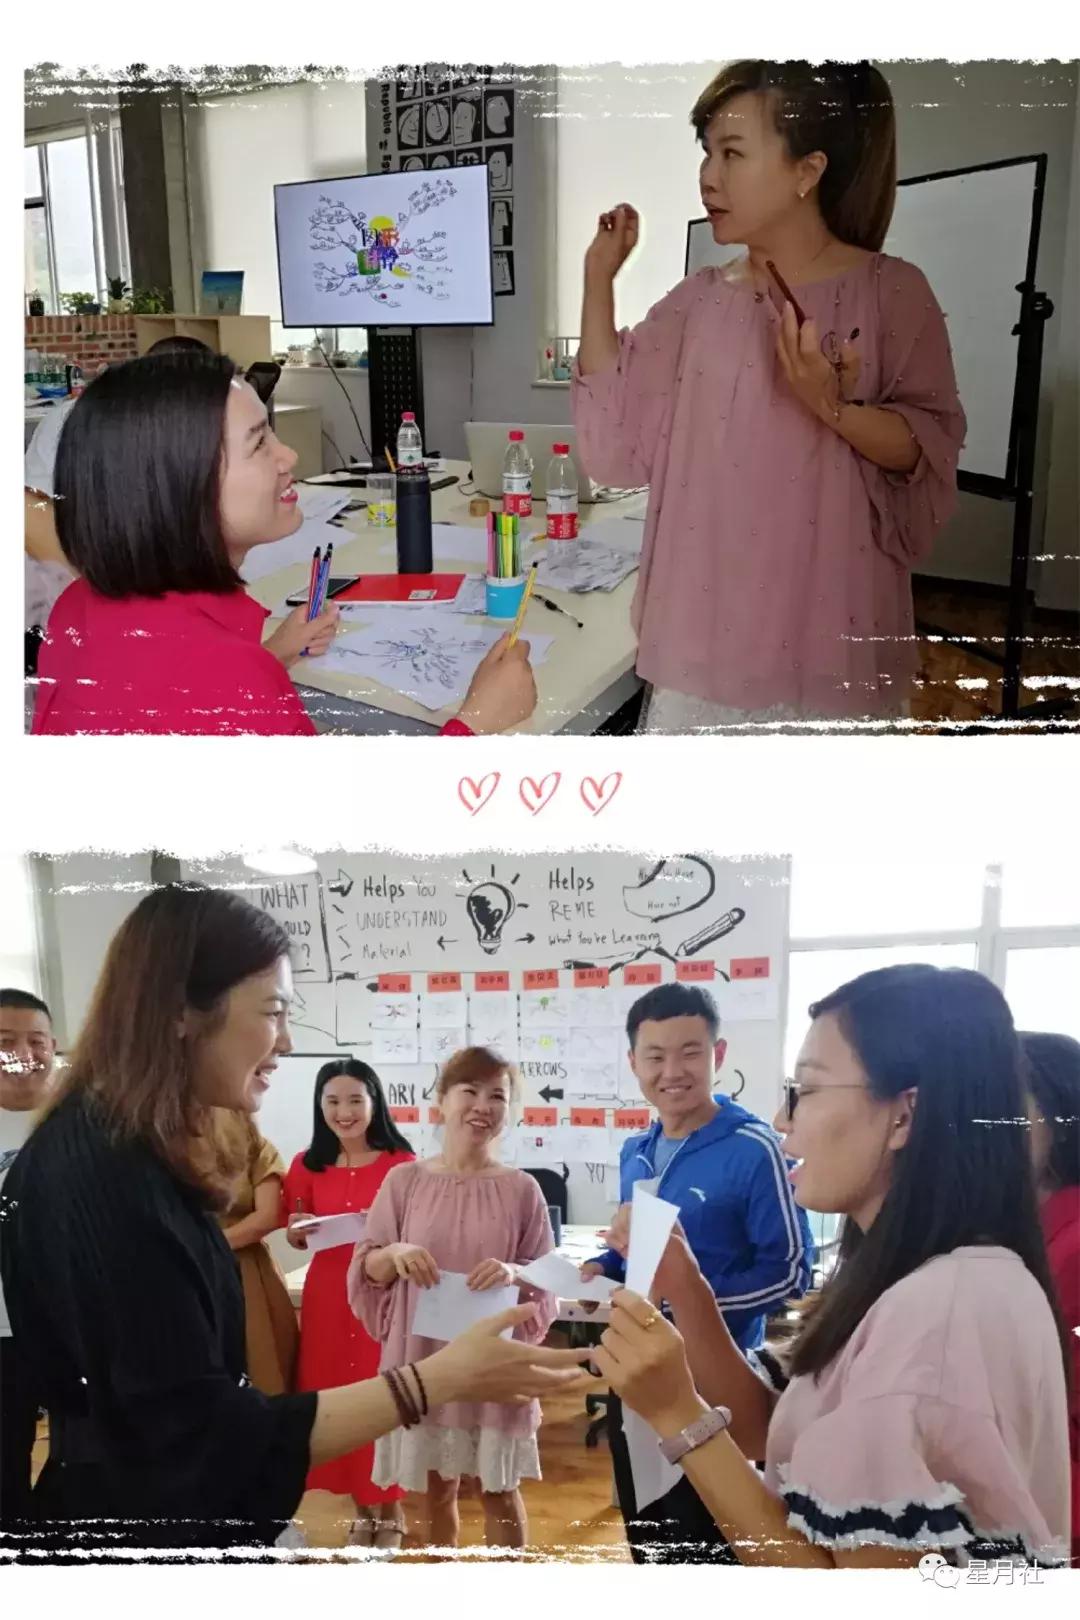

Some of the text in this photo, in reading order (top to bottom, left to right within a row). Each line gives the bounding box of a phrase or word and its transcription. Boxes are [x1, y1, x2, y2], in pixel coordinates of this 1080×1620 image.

[363, 873, 437, 904] Helps You
[549, 866, 594, 897] Helps
[260, 882, 309, 910] WHAT
[356, 909, 447, 931] UNDERSTAND
[520, 1061, 568, 1079] ARROWS
